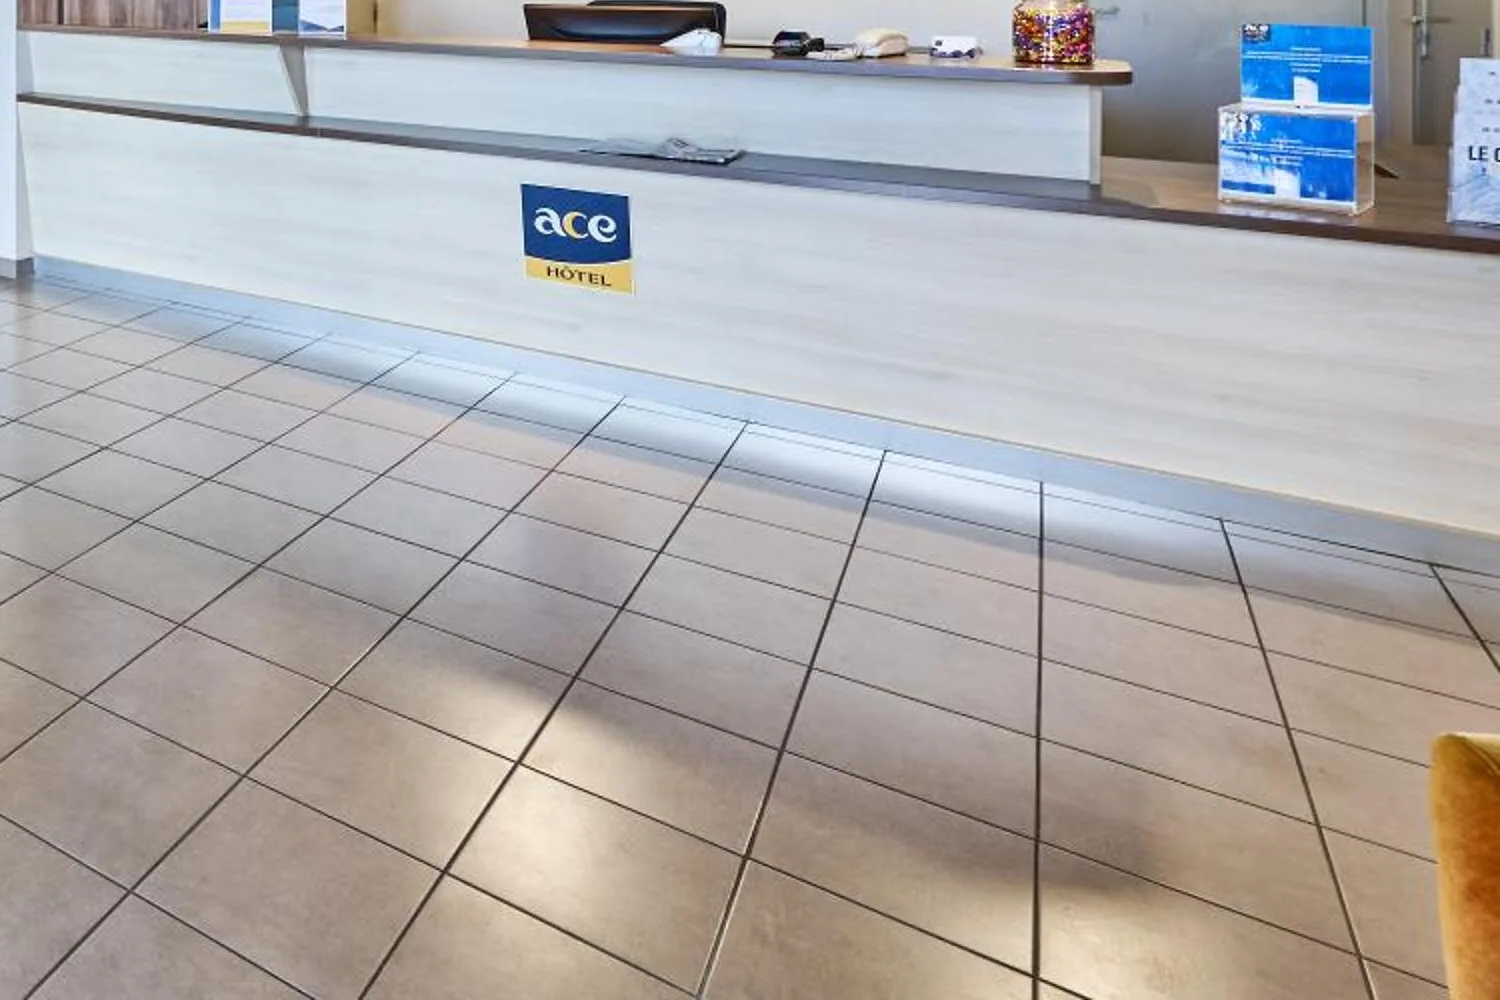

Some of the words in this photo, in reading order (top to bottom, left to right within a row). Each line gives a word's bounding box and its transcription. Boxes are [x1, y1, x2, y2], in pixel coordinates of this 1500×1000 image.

[1468, 146, 1489, 161] LE
[533, 206, 618, 243] ace
[546, 264, 612, 287] HÔTEL
